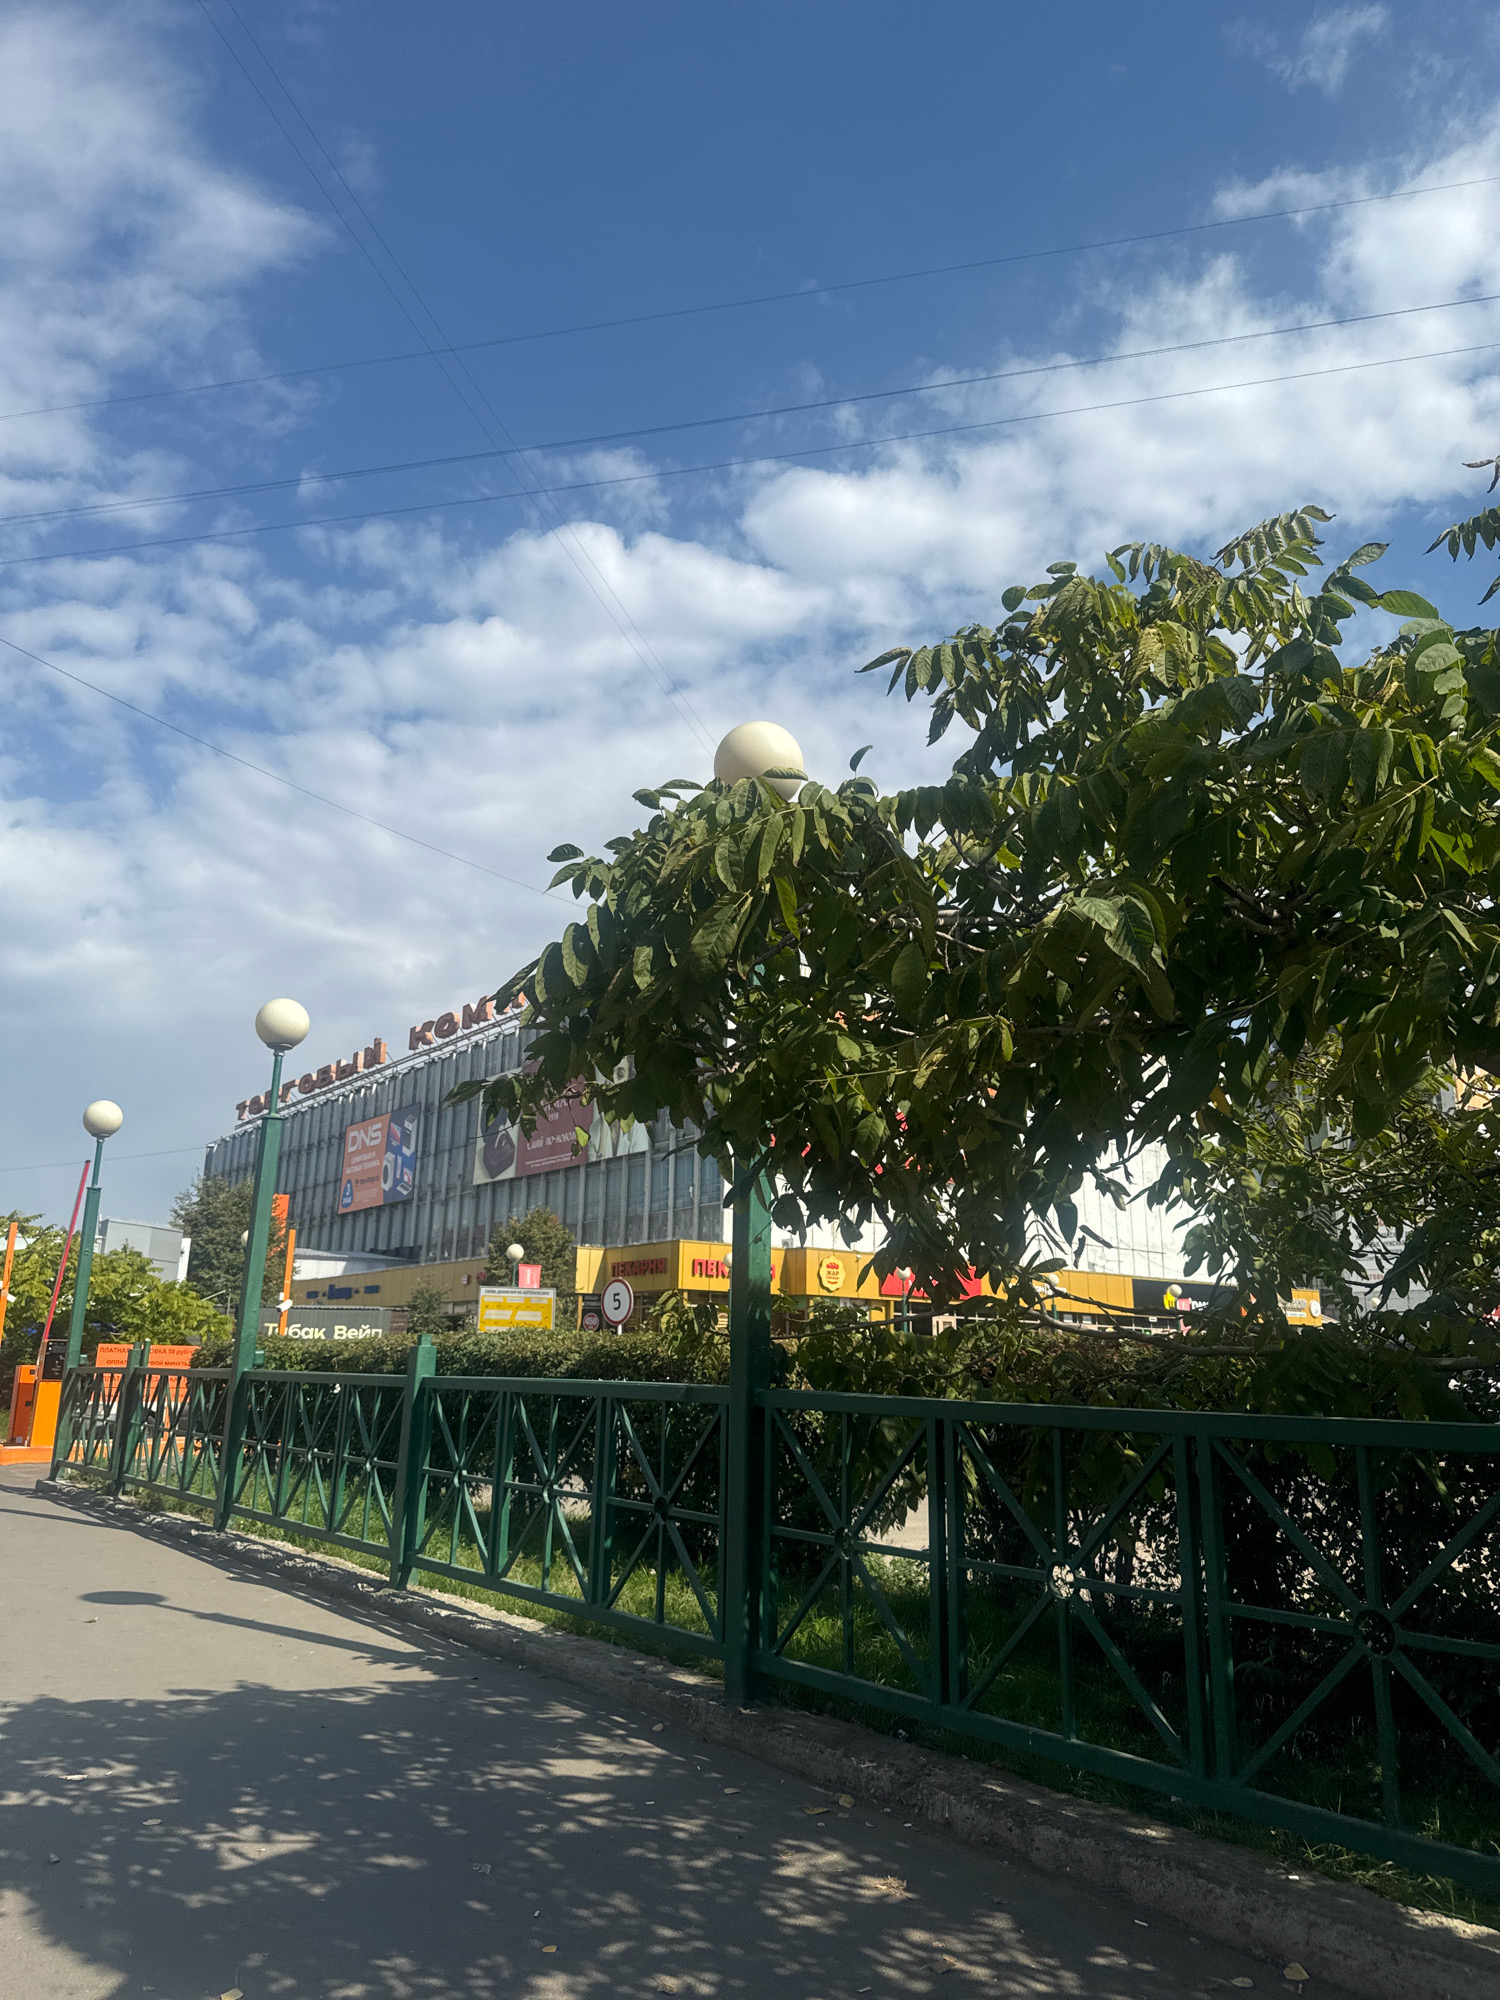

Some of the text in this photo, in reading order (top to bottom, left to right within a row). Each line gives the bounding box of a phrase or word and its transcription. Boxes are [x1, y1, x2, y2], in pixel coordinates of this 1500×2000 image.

[347, 1123, 382, 1154] DNS
[345, 1183, 351, 1196] 3
[611, 1257, 667, 1277] ПЕКАРНЯ
[612, 1292, 621, 1310] 5
[333, 1324, 383, 1340] Вейп
